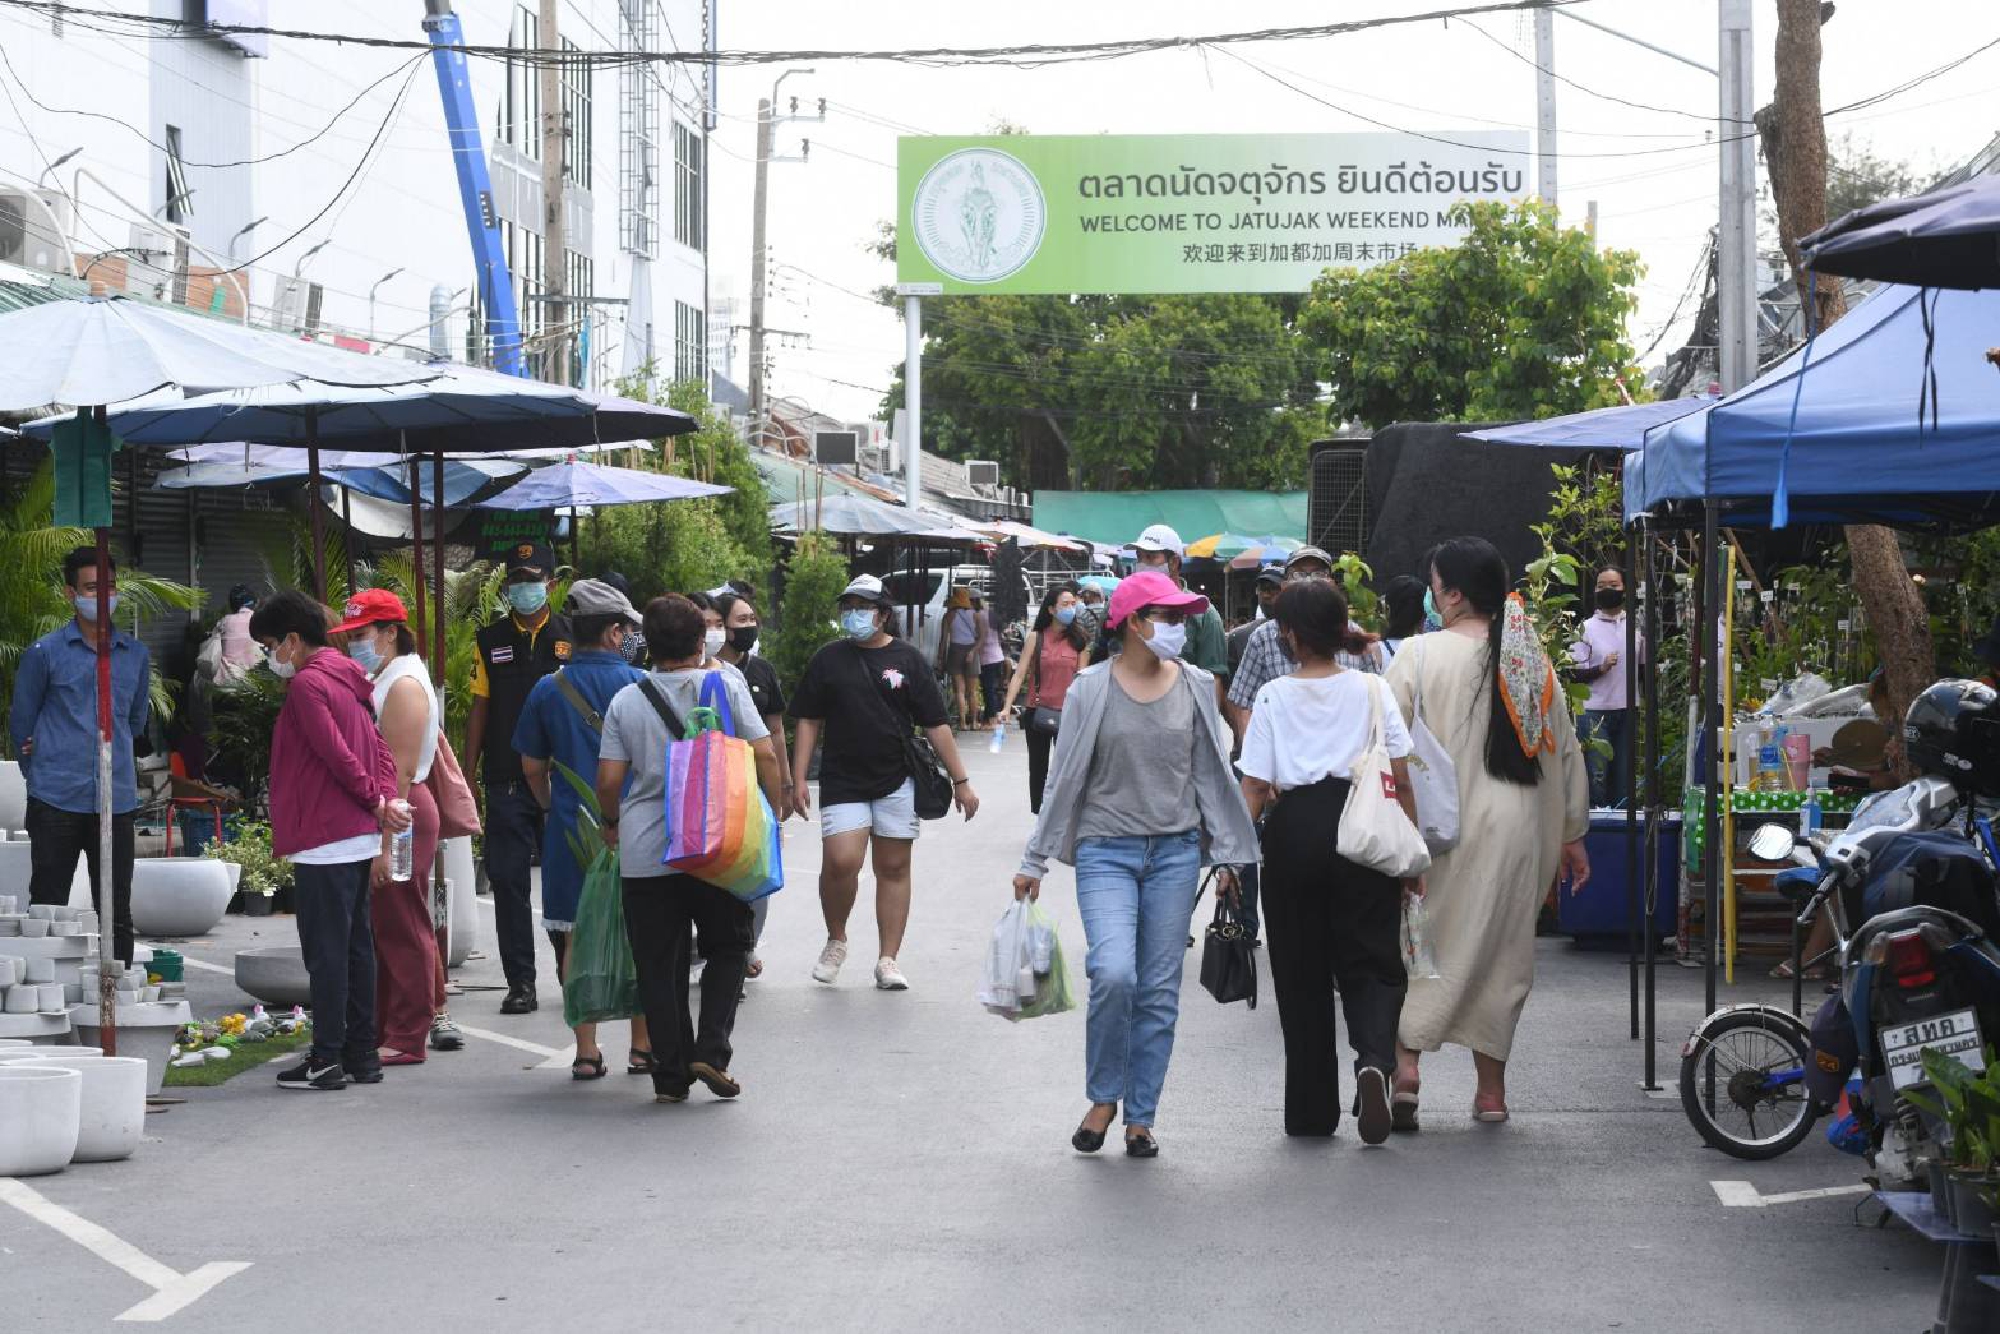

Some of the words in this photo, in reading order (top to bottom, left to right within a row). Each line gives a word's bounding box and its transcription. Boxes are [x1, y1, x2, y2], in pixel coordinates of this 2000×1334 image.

[1079, 163, 1327, 205] ตลาดนัดจตุจักร
[1338, 161, 1522, 194] ยินดีต้อนรับ
[1080, 213, 1187, 232] WELCOME
[1193, 212, 1222, 230] TO
[1228, 212, 1321, 231] JATUJAK
[1327, 211, 1429, 229] WEEKEND
